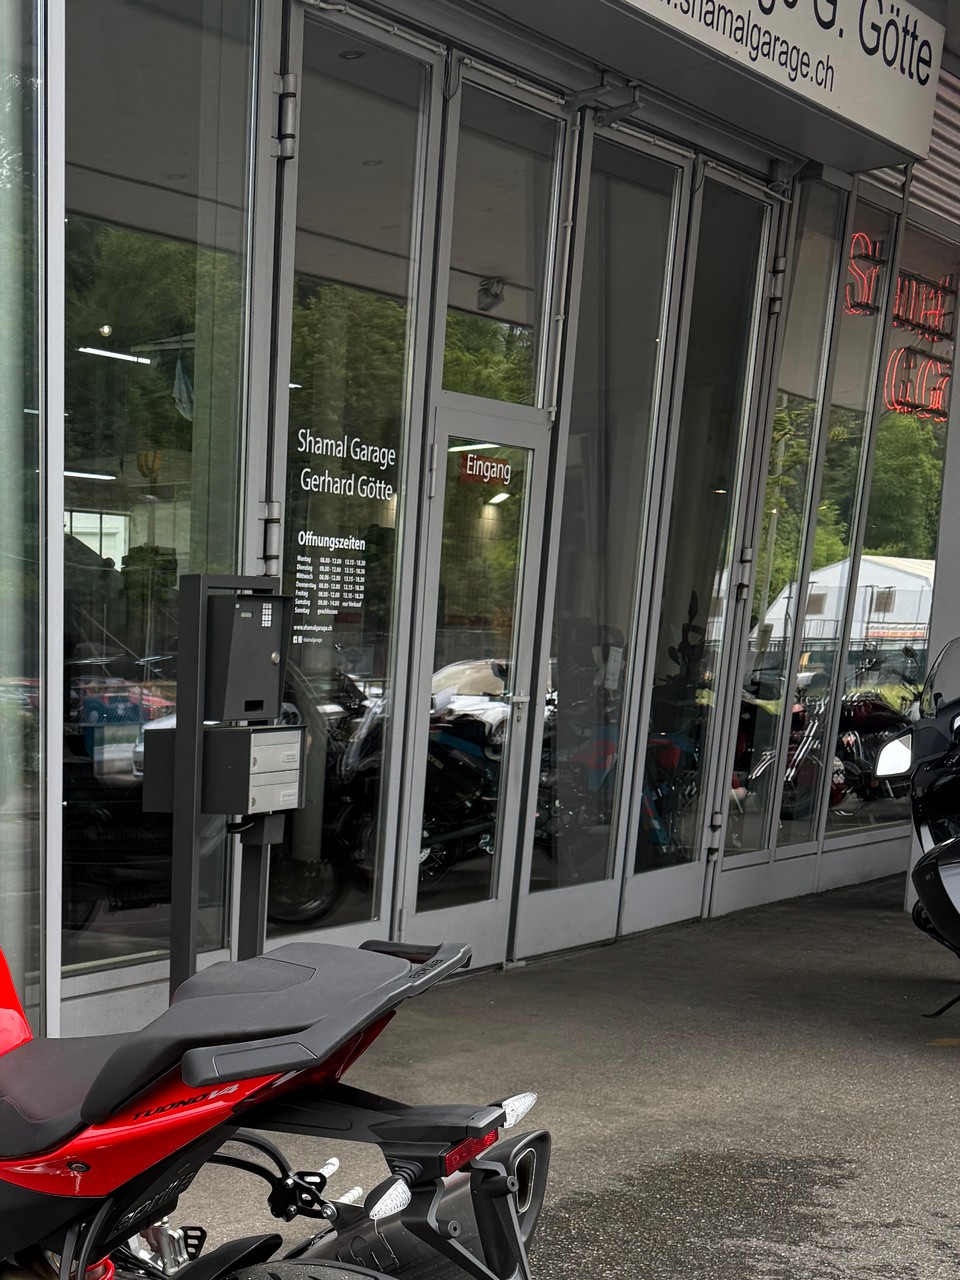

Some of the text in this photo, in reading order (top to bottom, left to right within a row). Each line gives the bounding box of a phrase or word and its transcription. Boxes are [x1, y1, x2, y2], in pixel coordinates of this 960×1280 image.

[656, 0, 835, 92] .shamalgarage.ch
[858, 0, 933, 86] Götte
[297, 428, 396, 470] Shamal Garage
[466, 453, 512, 485] Eingang
[300, 468, 393, 501] Gerhard Götte
[132, 1083, 240, 1121] TUONO V4
